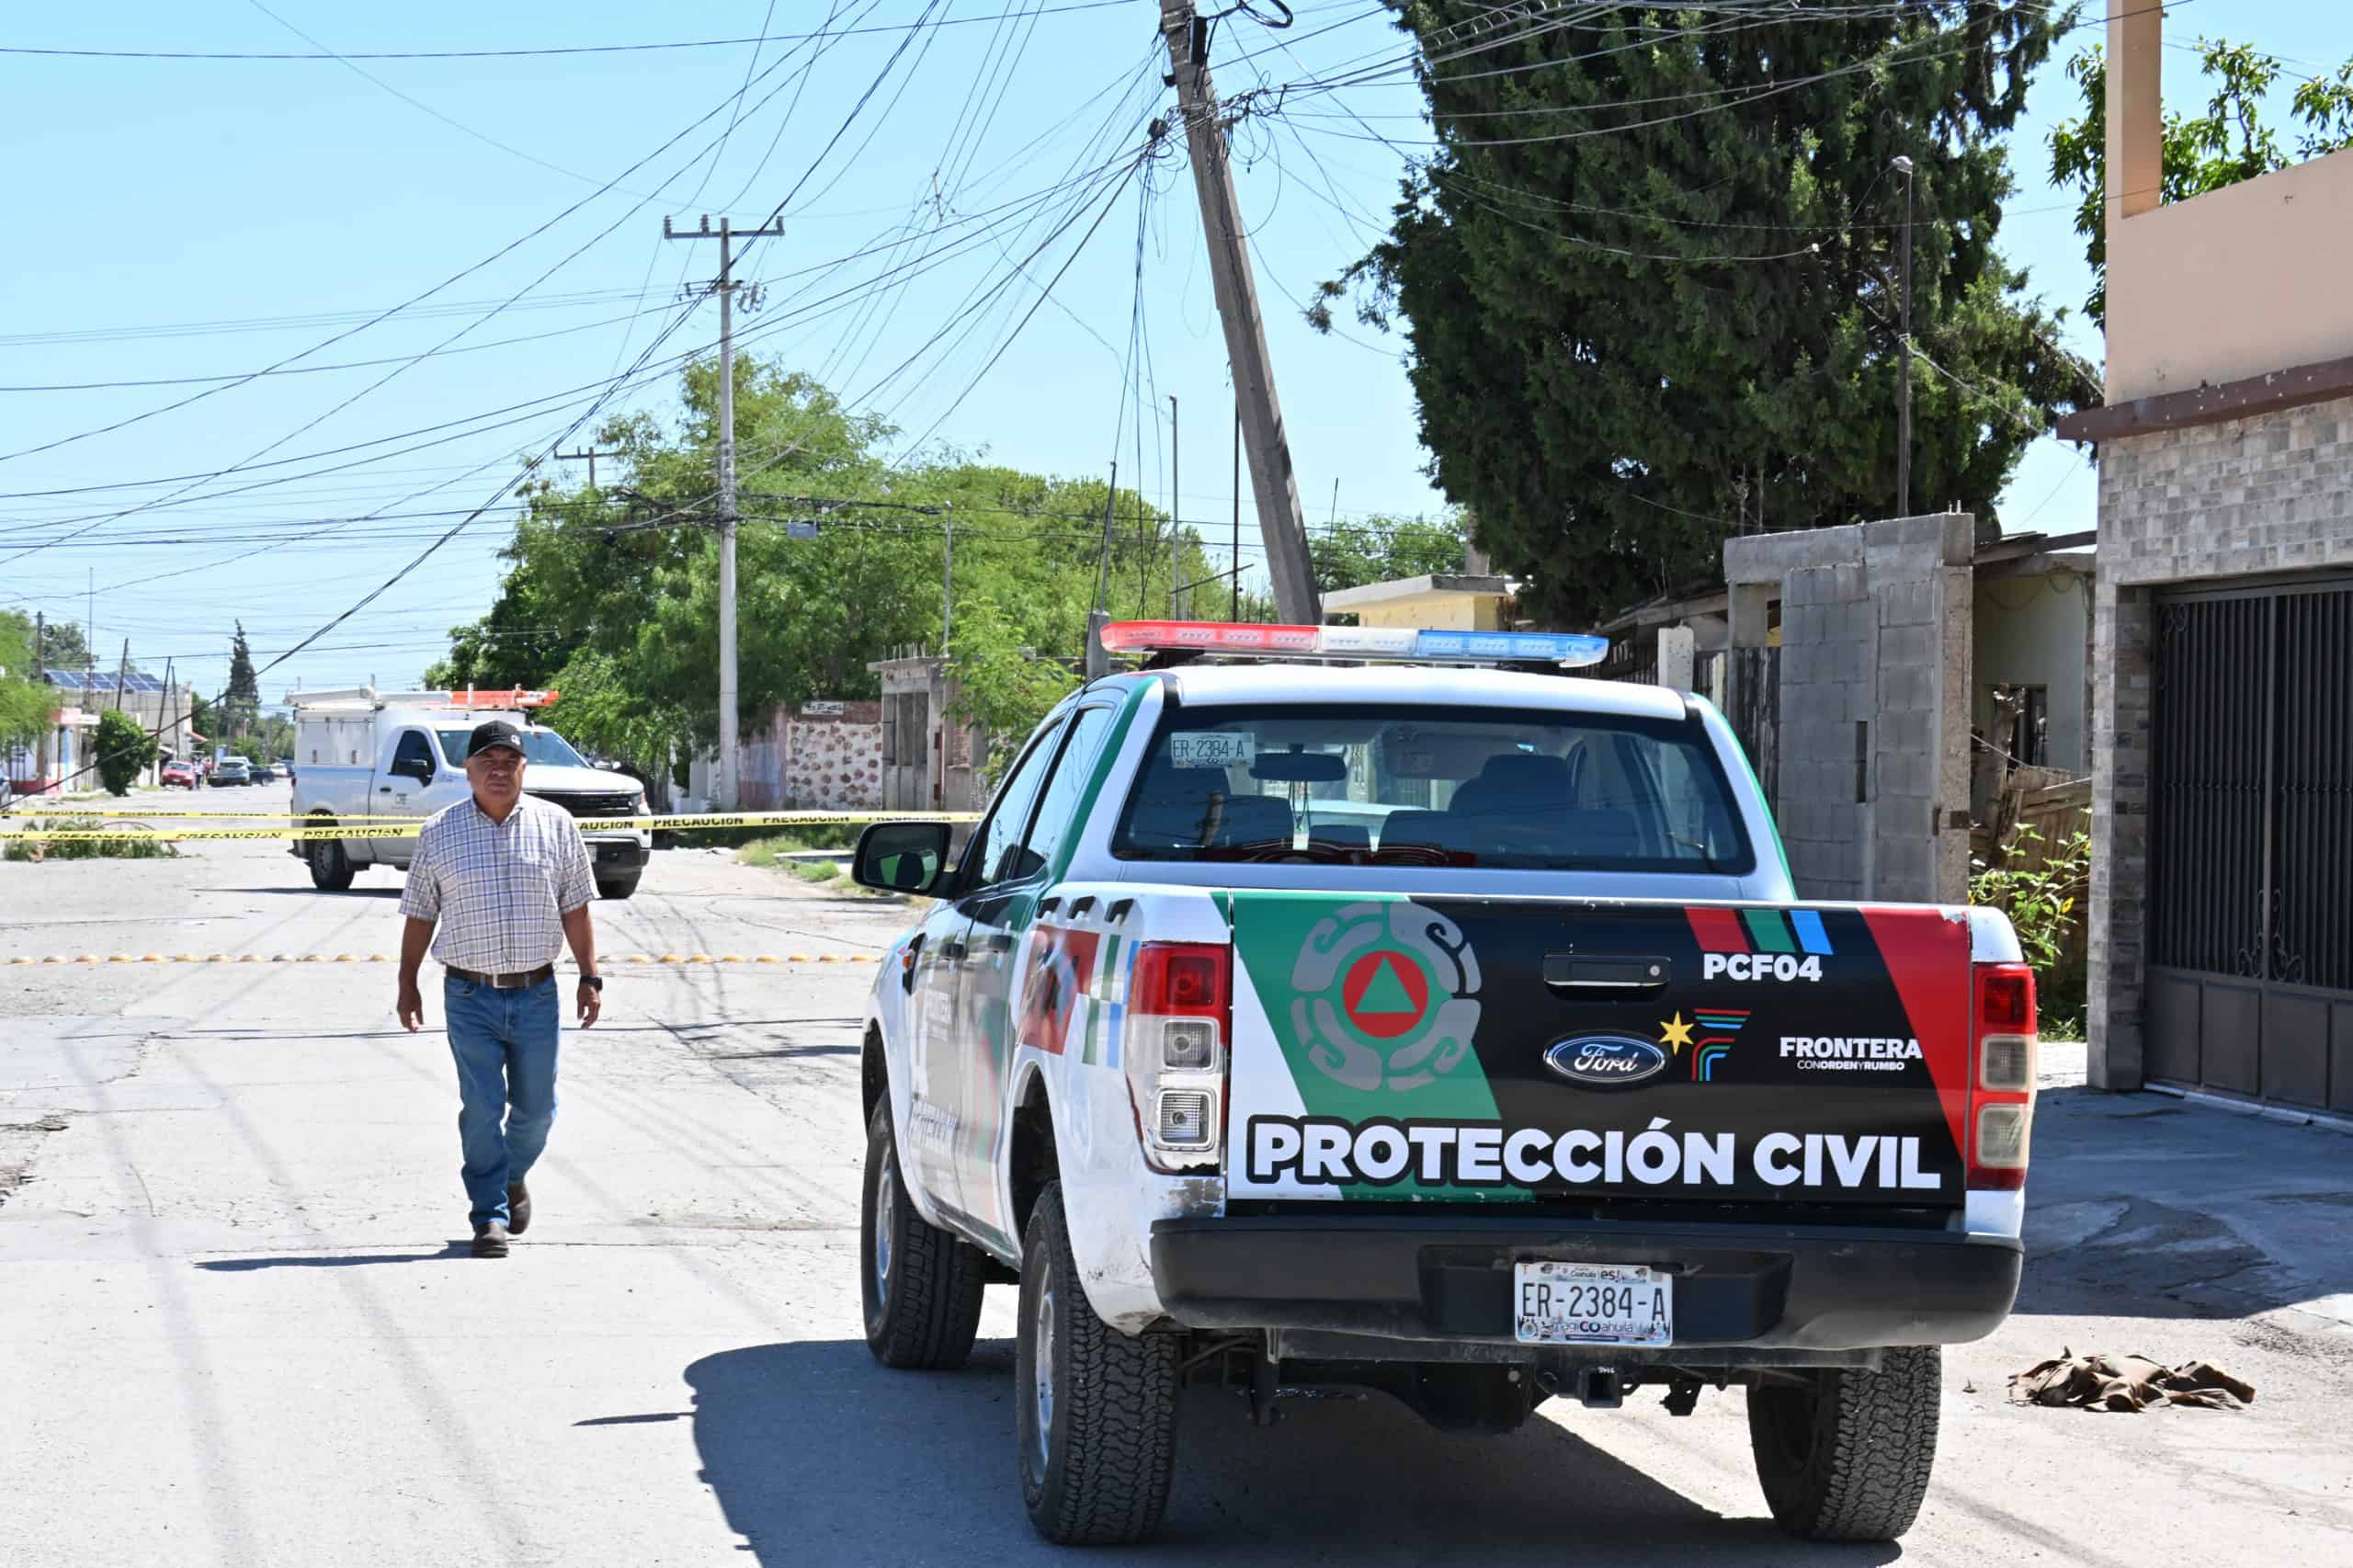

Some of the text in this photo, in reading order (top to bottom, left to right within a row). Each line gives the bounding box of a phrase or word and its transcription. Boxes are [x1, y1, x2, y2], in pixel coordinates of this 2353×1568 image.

[1172, 739, 1245, 758] ER-2384-A
[1703, 953, 1823, 983] PCF04
[1574, 1043, 1640, 1072] Ford
[1779, 1036, 1923, 1060] FRONTERA
[1254, 1117, 1941, 1189] PROTECCIÓN CIVIL
[1522, 1282, 1665, 1322] ER-2384-A
